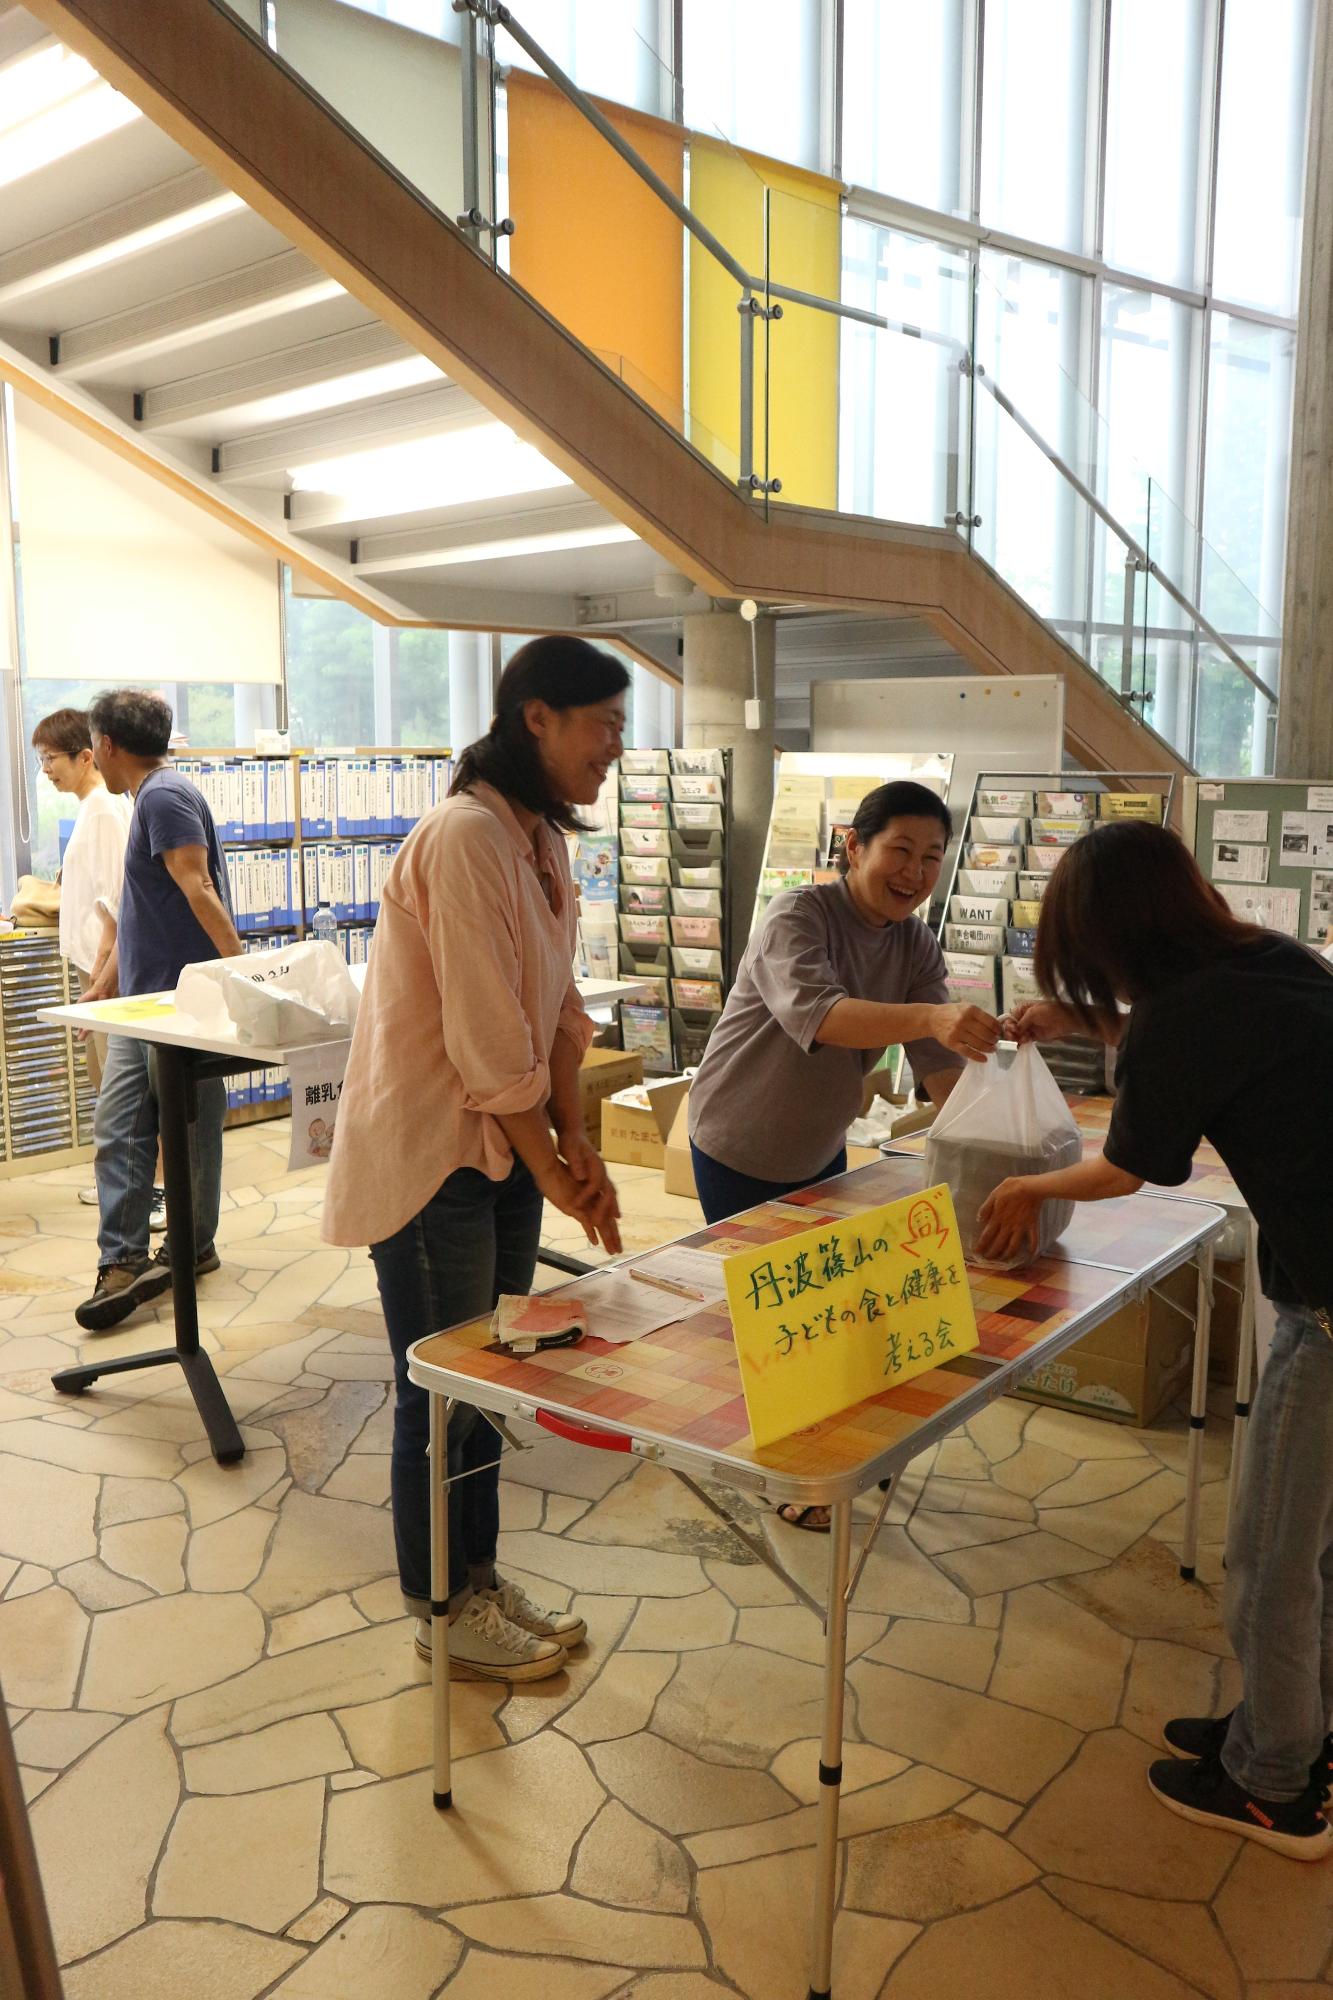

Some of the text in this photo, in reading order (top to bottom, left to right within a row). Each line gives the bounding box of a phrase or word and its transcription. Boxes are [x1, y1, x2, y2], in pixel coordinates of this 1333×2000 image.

[959, 908, 992, 921] WANT
[745, 1235, 888, 1311] 丹波篠山の
[775, 1260, 961, 1355] 子どもの食と健康を
[884, 1318, 956, 1376] 考える会
